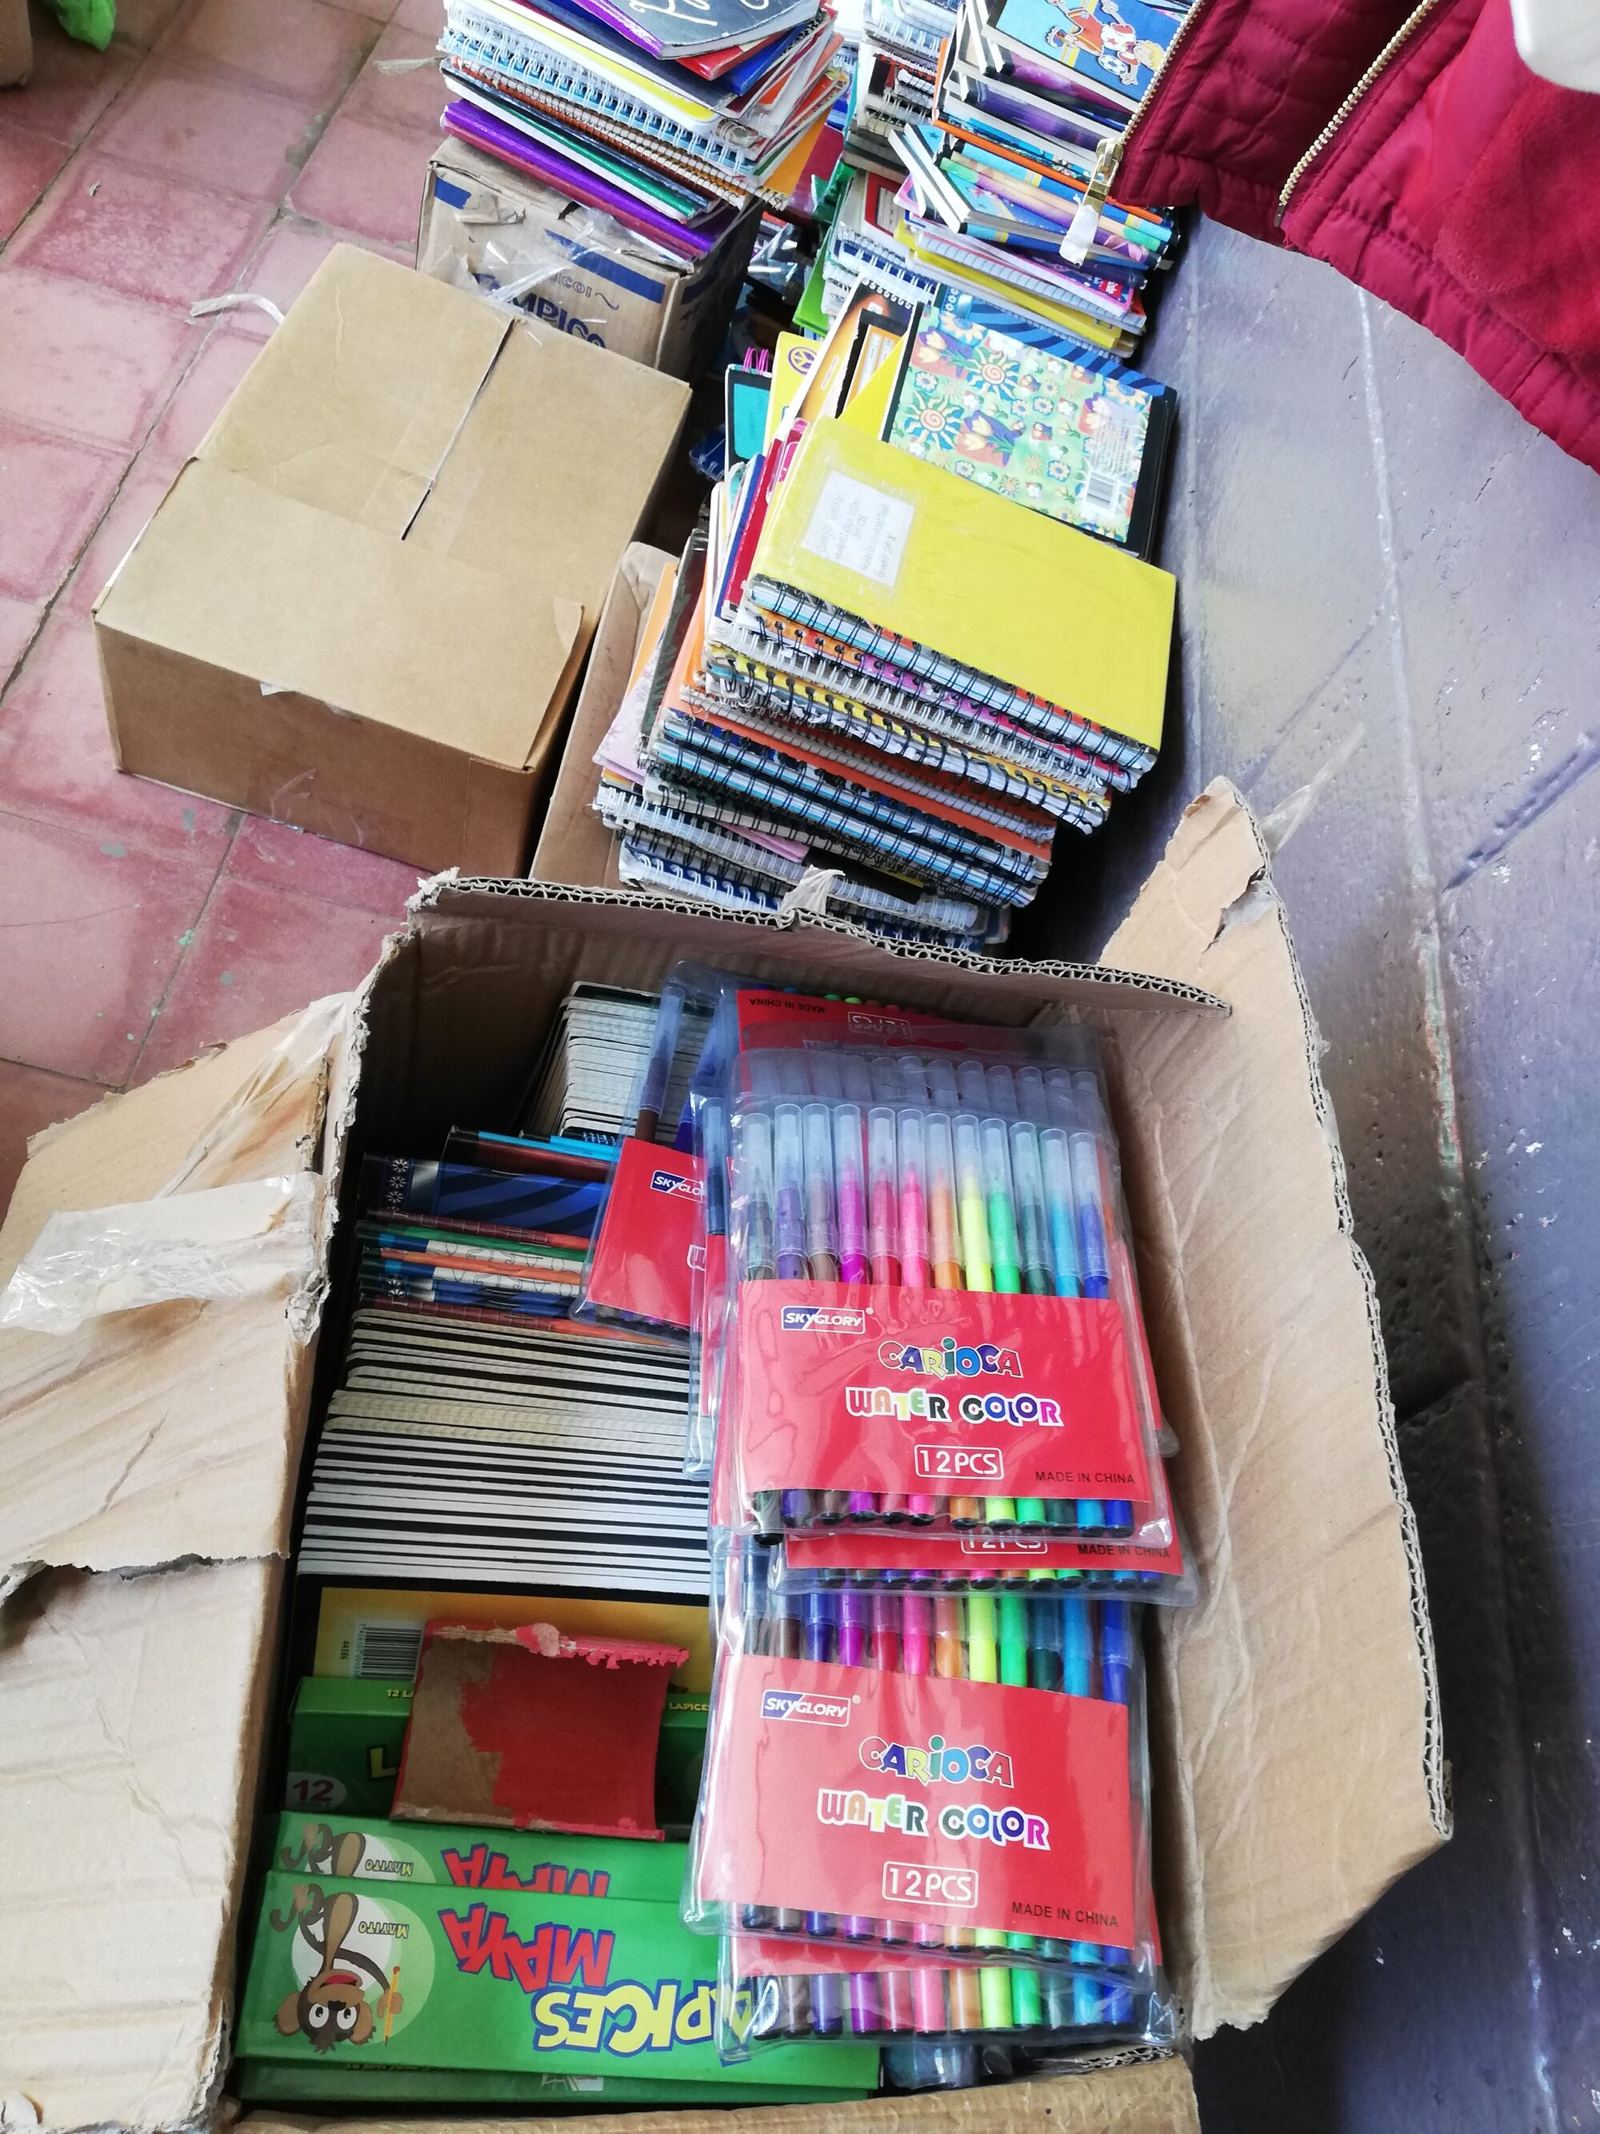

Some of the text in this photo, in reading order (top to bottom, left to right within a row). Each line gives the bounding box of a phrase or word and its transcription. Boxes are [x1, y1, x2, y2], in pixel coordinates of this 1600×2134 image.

[749, 998, 782, 1008] CHINA
[799, 1004, 826, 1013] MADE
[654, 1176, 705, 1196] SKYGLO
[784, 1312, 862, 1328] SKYGLORY
[845, 1387, 1064, 1427] WATER COLOR
[919, 1449, 998, 1475] 12PCS
[1035, 1471, 1136, 1484] MADE IN CHINA
[1077, 1544, 1169, 1558] MADE IN CHINA
[765, 1697, 847, 1718] SKYGLORY
[293, 1779, 334, 1801] 12
[817, 1789, 1051, 1851] WATER COLOR
[365, 1859, 413, 1877] MAYITO
[889, 1867, 972, 1901] 12PCS
[1012, 1902, 1119, 1927] MADE IN CHINA
[358, 1921, 409, 1939] MAYITO
[438, 1903, 615, 1994] MAYA
[534, 1979, 752, 2057] APICES
